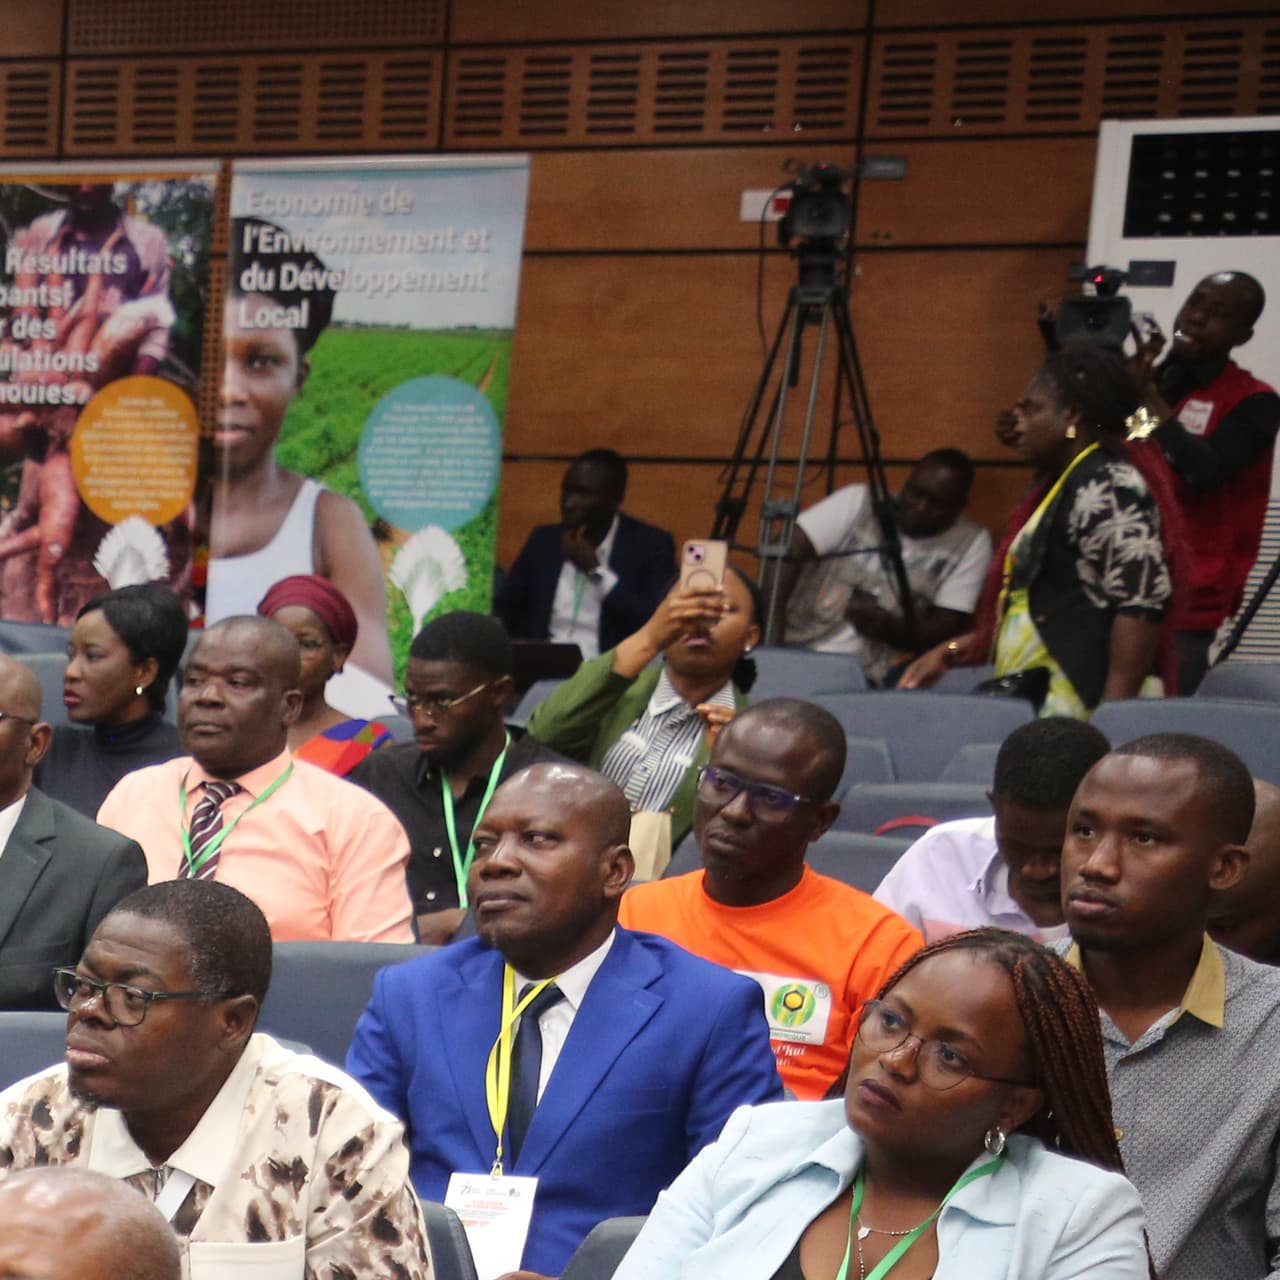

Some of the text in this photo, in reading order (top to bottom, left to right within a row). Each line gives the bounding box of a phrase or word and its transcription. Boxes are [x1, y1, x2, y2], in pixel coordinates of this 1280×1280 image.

[381, 185, 416, 216] de
[464, 227, 493, 253] et
[241, 260, 489, 298] du Développement
[12, 314, 57, 339] des
[240, 299, 309, 329] Local
